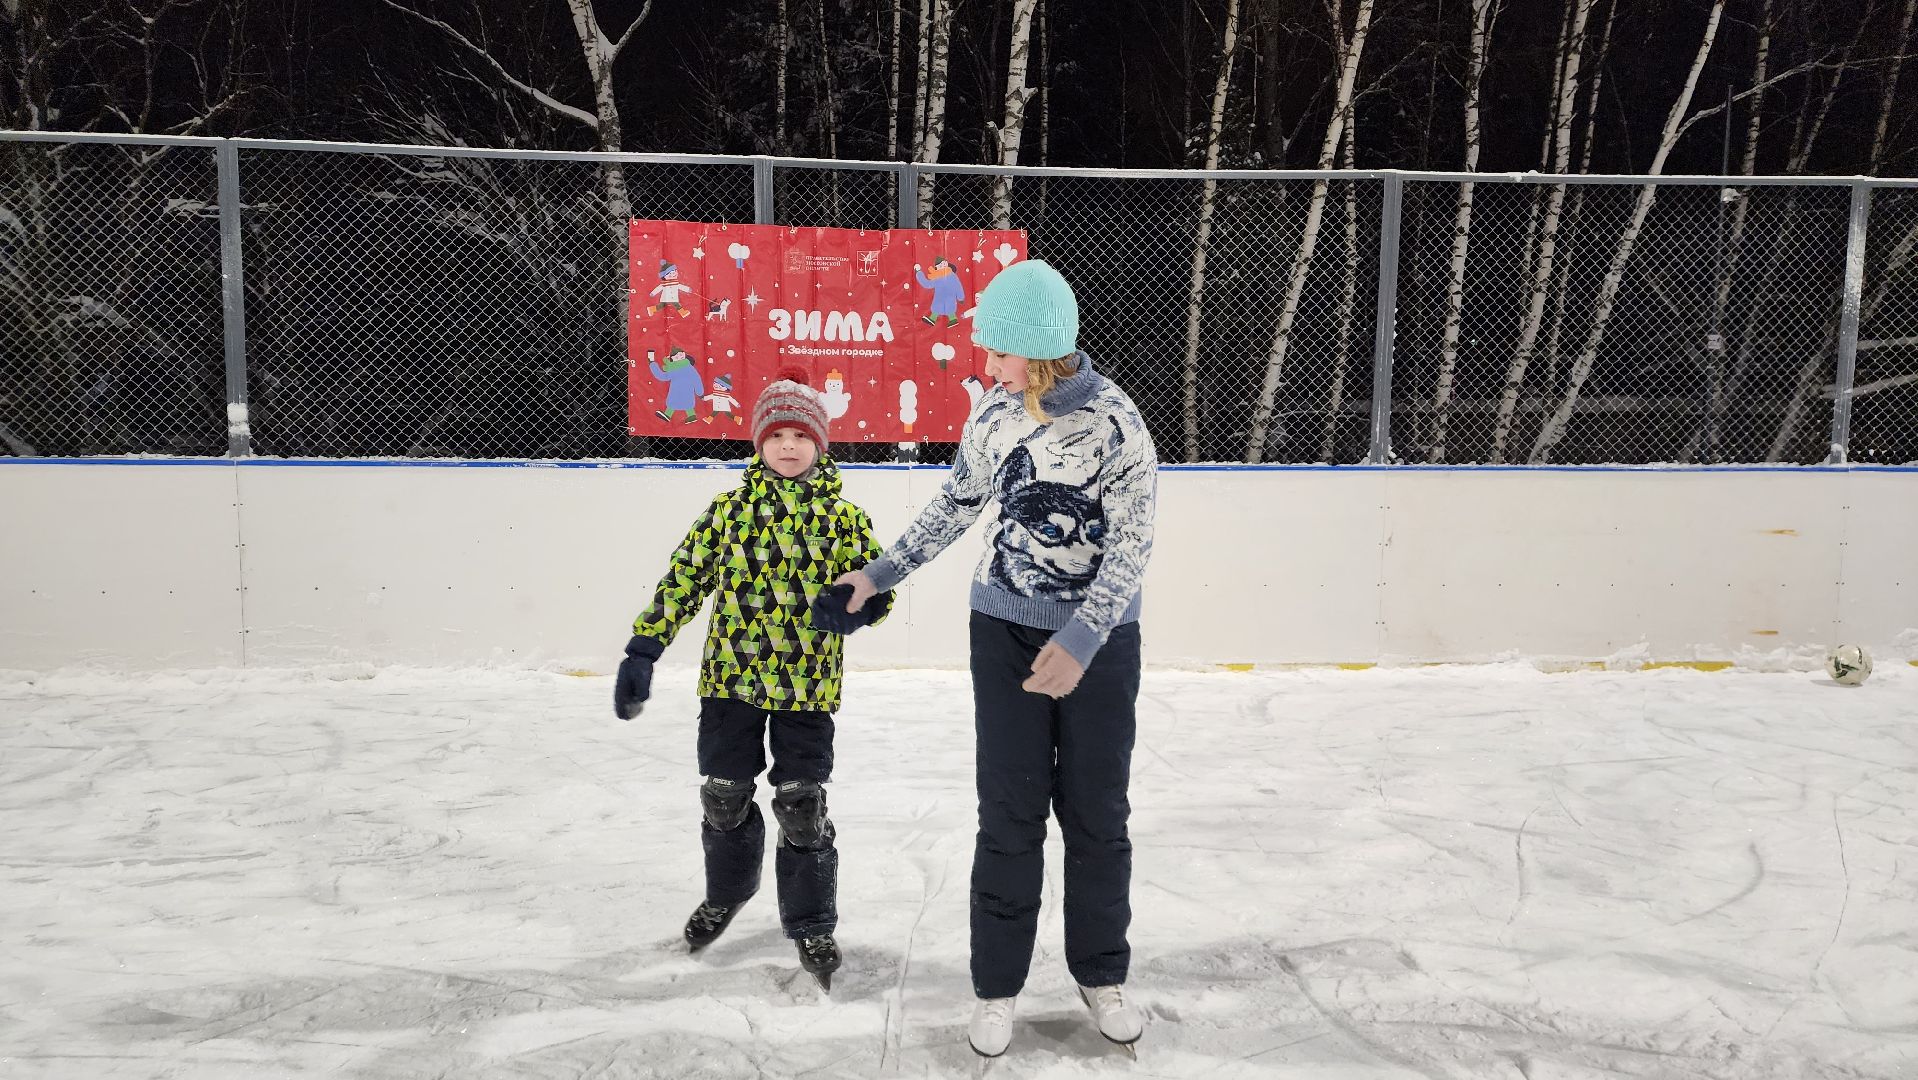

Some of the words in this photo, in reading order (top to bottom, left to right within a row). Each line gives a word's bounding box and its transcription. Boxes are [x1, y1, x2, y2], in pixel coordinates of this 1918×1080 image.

[768, 308, 895, 342] ЗИМА
[787, 344, 840, 356] Звёздном
[841, 348, 884, 358] городке
